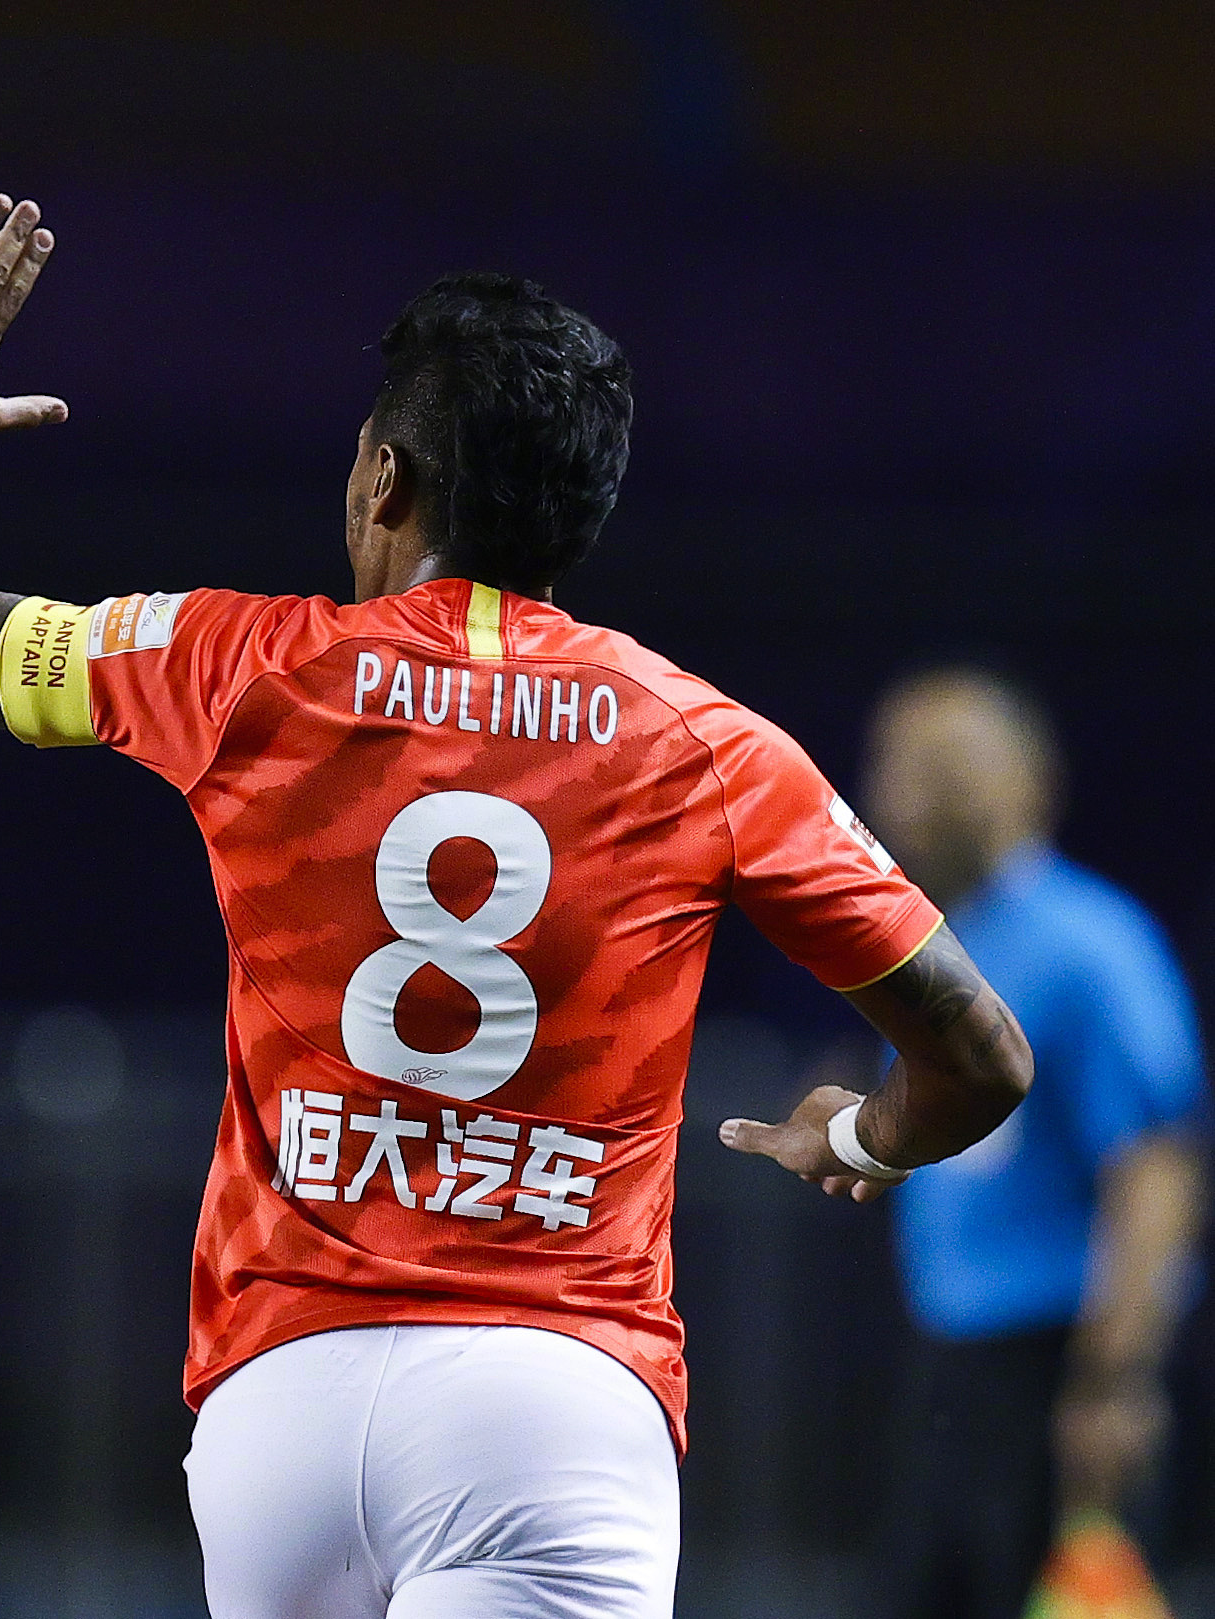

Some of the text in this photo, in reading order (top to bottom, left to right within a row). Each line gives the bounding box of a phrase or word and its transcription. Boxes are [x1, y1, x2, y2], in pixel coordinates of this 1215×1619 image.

[140, 611, 154, 631] CSL
[353, 651, 619, 745] PAULINHO
[340, 790, 552, 1102] 8
[270, 1087, 606, 1232] 恒大汽车
